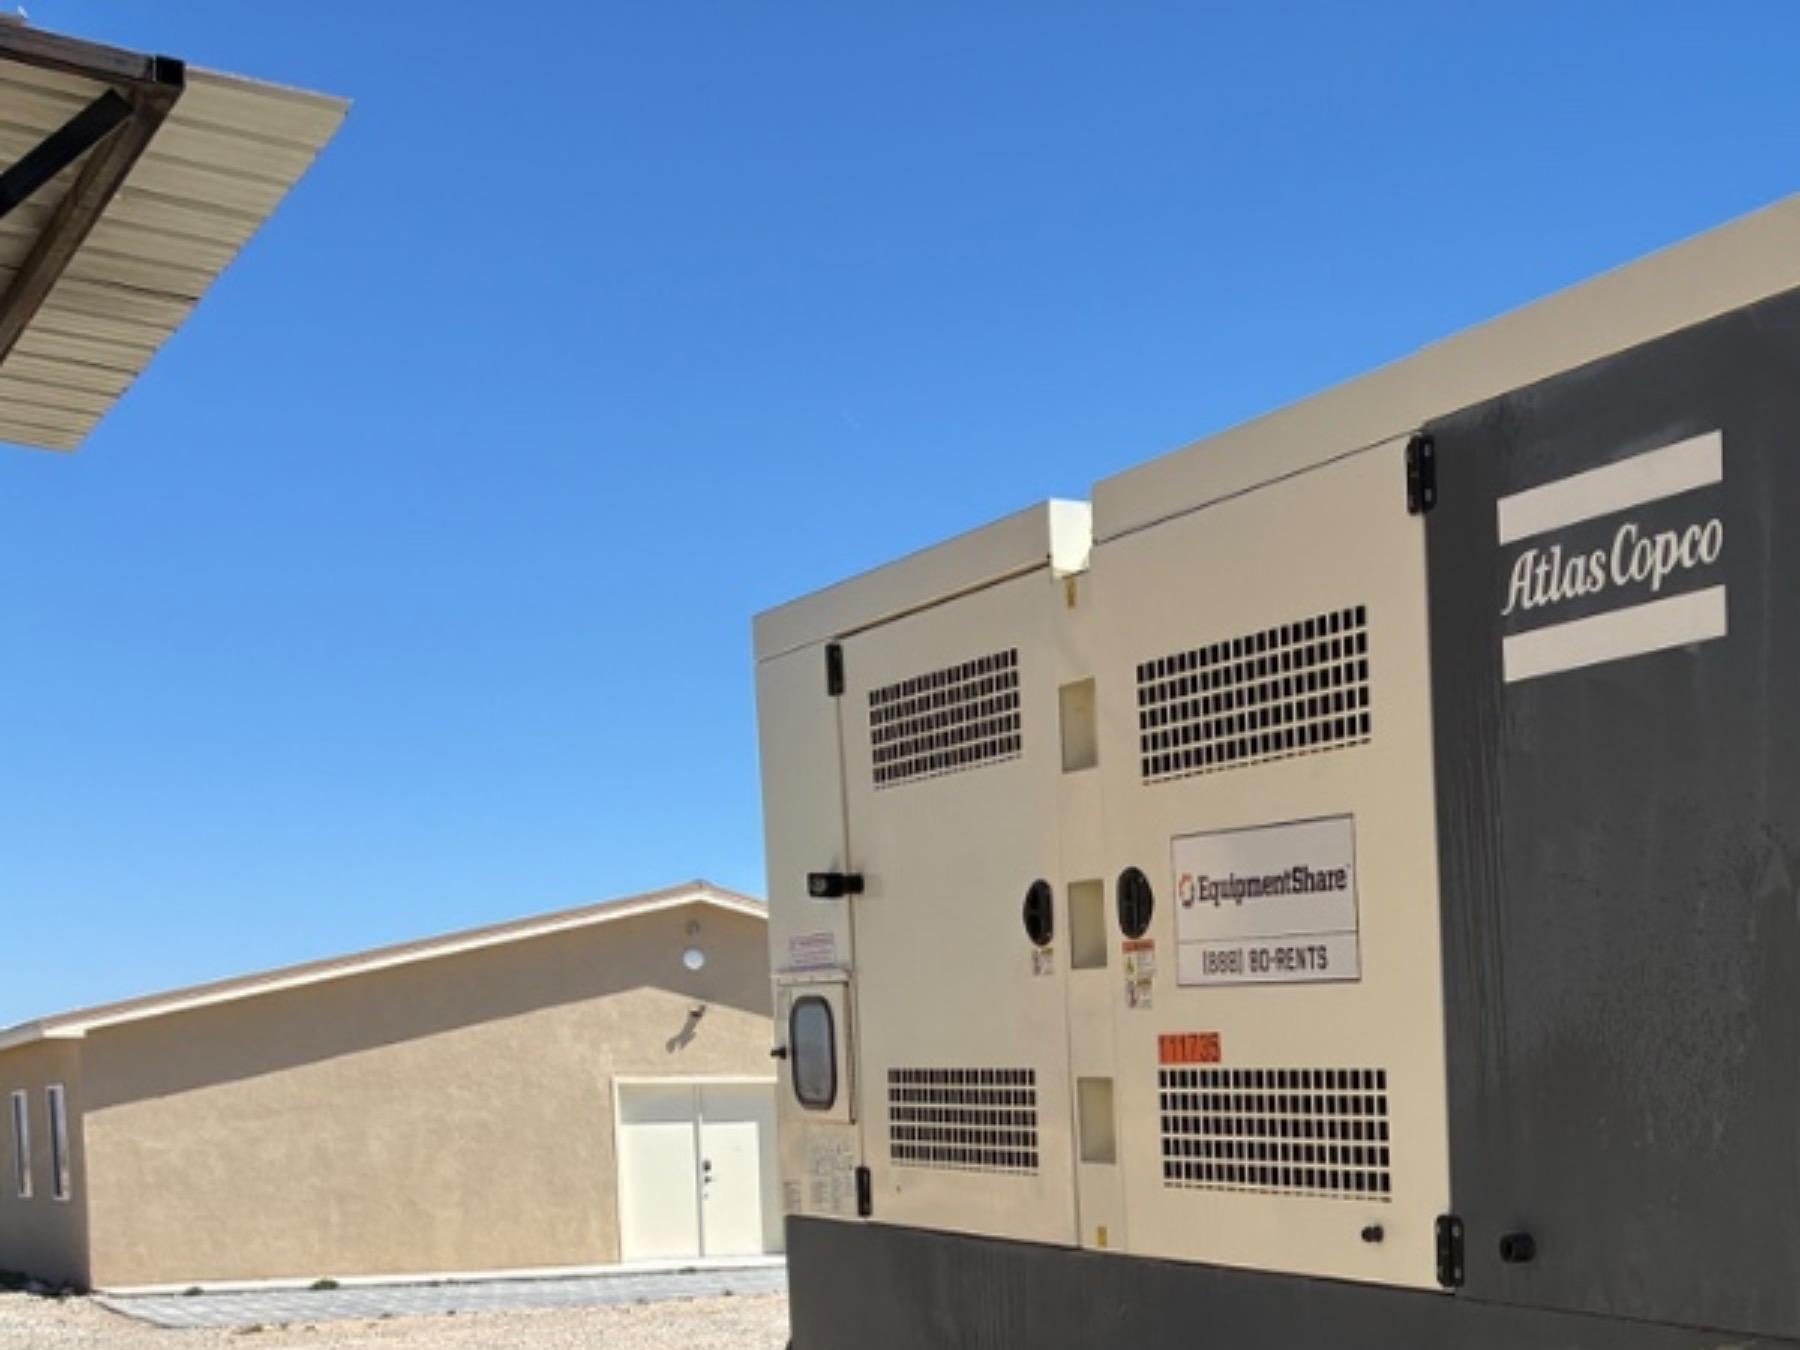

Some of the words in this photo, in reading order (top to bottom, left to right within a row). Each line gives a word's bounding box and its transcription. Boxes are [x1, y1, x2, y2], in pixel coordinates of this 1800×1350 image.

[1501, 545, 1606, 616] Atlas
[1610, 518, 1723, 592] Copco
[1198, 865, 1347, 907] EquipmentShare
[1202, 948, 1243, 976] (888)
[1250, 944, 1328, 973] 80-RENTS
